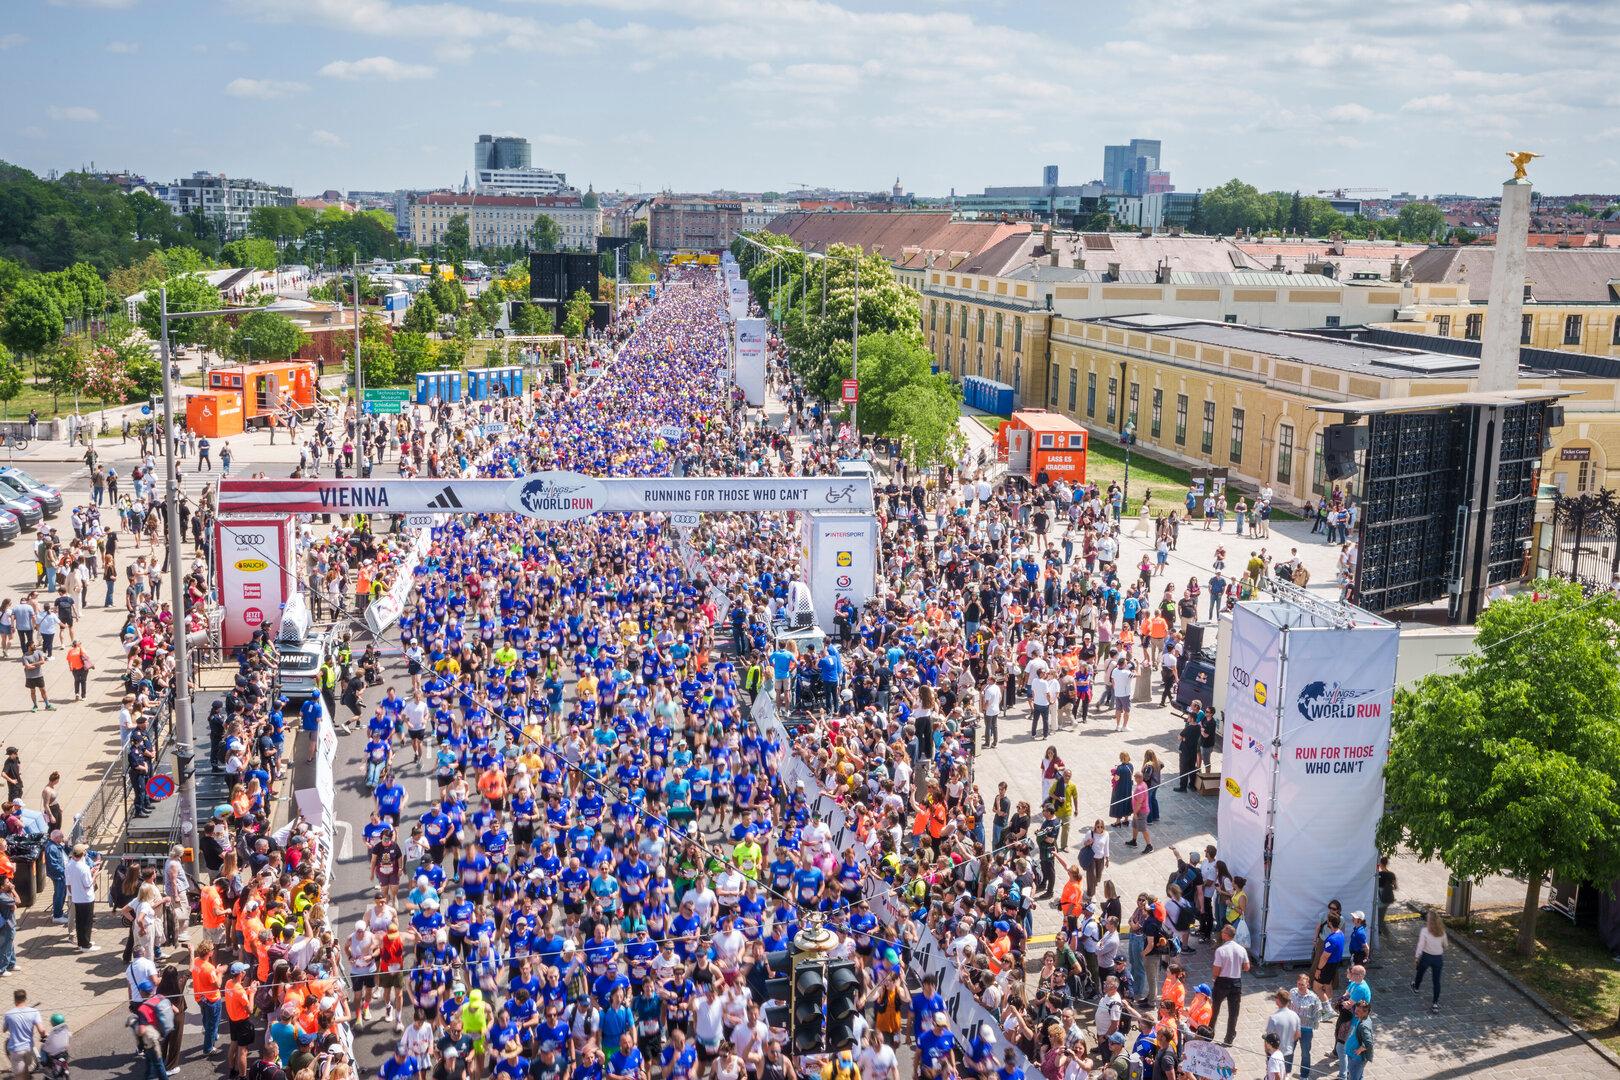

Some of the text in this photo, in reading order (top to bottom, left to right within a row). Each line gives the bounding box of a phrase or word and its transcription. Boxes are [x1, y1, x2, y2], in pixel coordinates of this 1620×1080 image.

[318, 486, 389, 507] VIENNA
[644, 488, 809, 501] RUNNING FOR THOSE WHO CAN'T
[532, 498, 593, 510] WORLD RUN
[1325, 690, 1356, 698] WINGS
[1311, 703, 1381, 719] WORLD RUN
[1295, 745, 1374, 759] RUN FOR THOSE
[1305, 760, 1364, 774] WHO CAN'T
